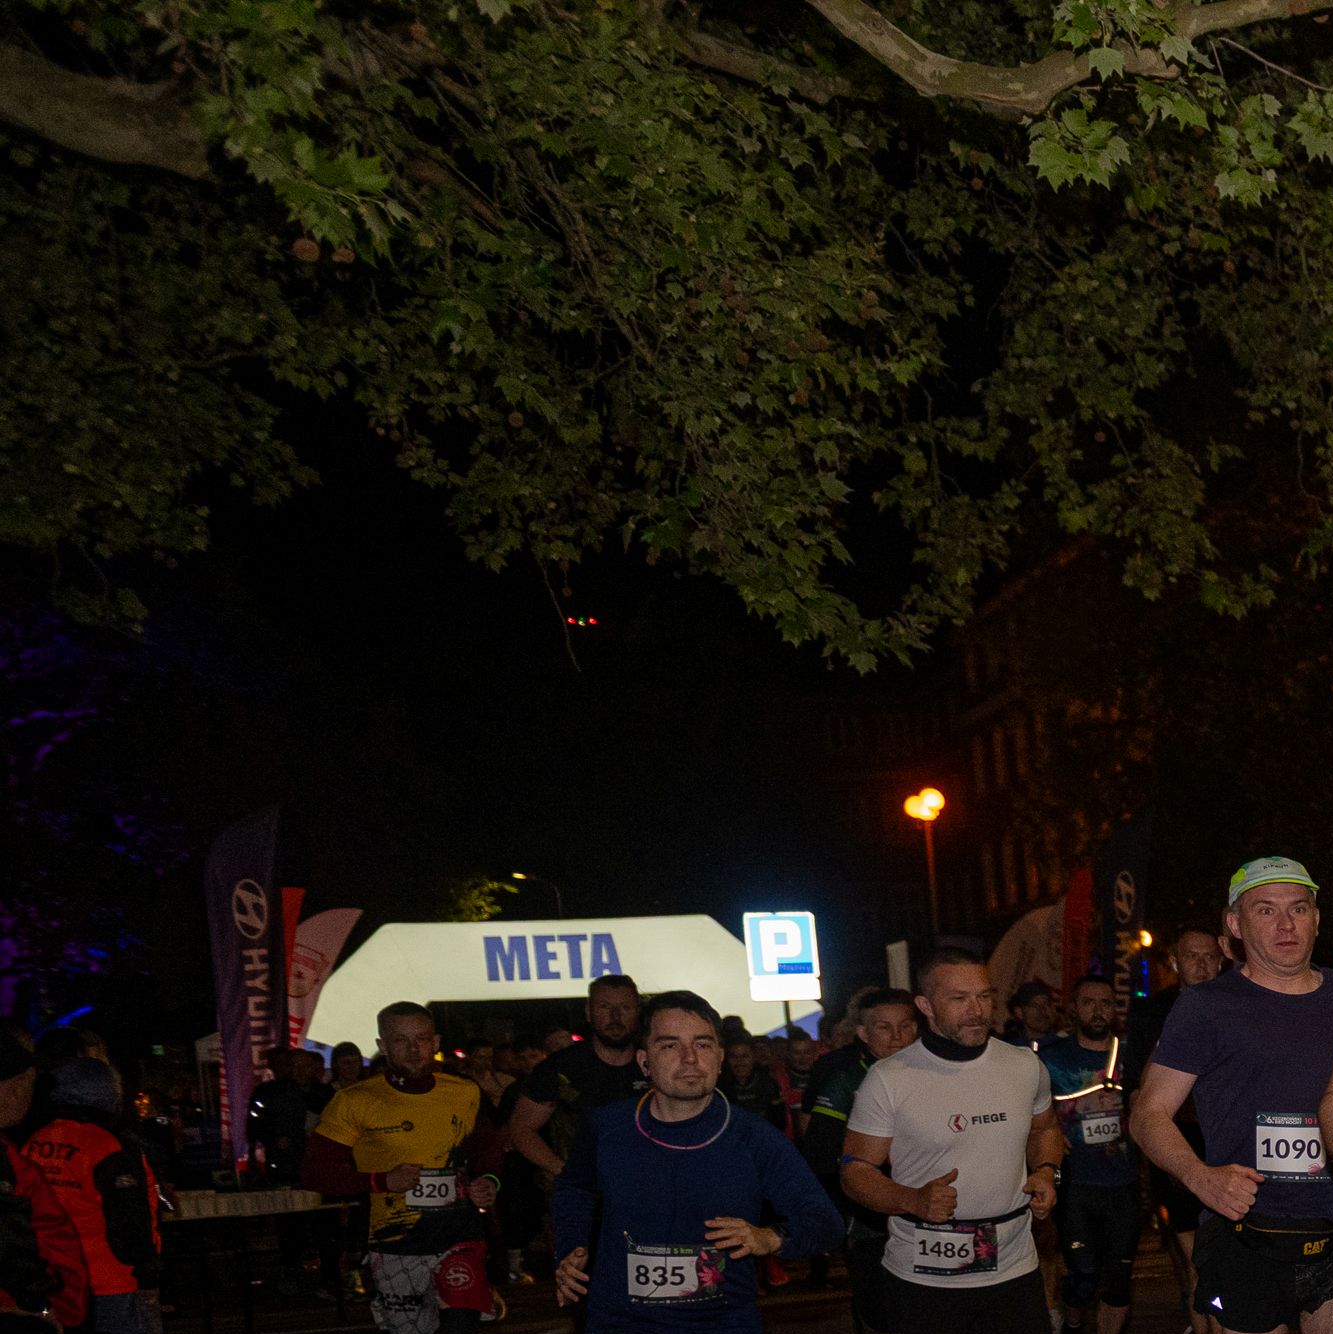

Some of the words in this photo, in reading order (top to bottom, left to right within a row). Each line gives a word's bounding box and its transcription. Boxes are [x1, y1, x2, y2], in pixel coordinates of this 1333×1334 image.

[758, 920, 803, 972] P
[483, 932, 623, 982] META
[971, 1112, 1008, 1125] FIEGE
[1304, 1117, 1313, 1125] 10
[1086, 1123, 1120, 1137] 1402
[1260, 1138, 1321, 1160] 1090
[412, 1183, 450, 1198] 820
[918, 1239, 970, 1258] 1486
[1303, 1238, 1328, 1256] CAT
[635, 1265, 685, 1286] 835
